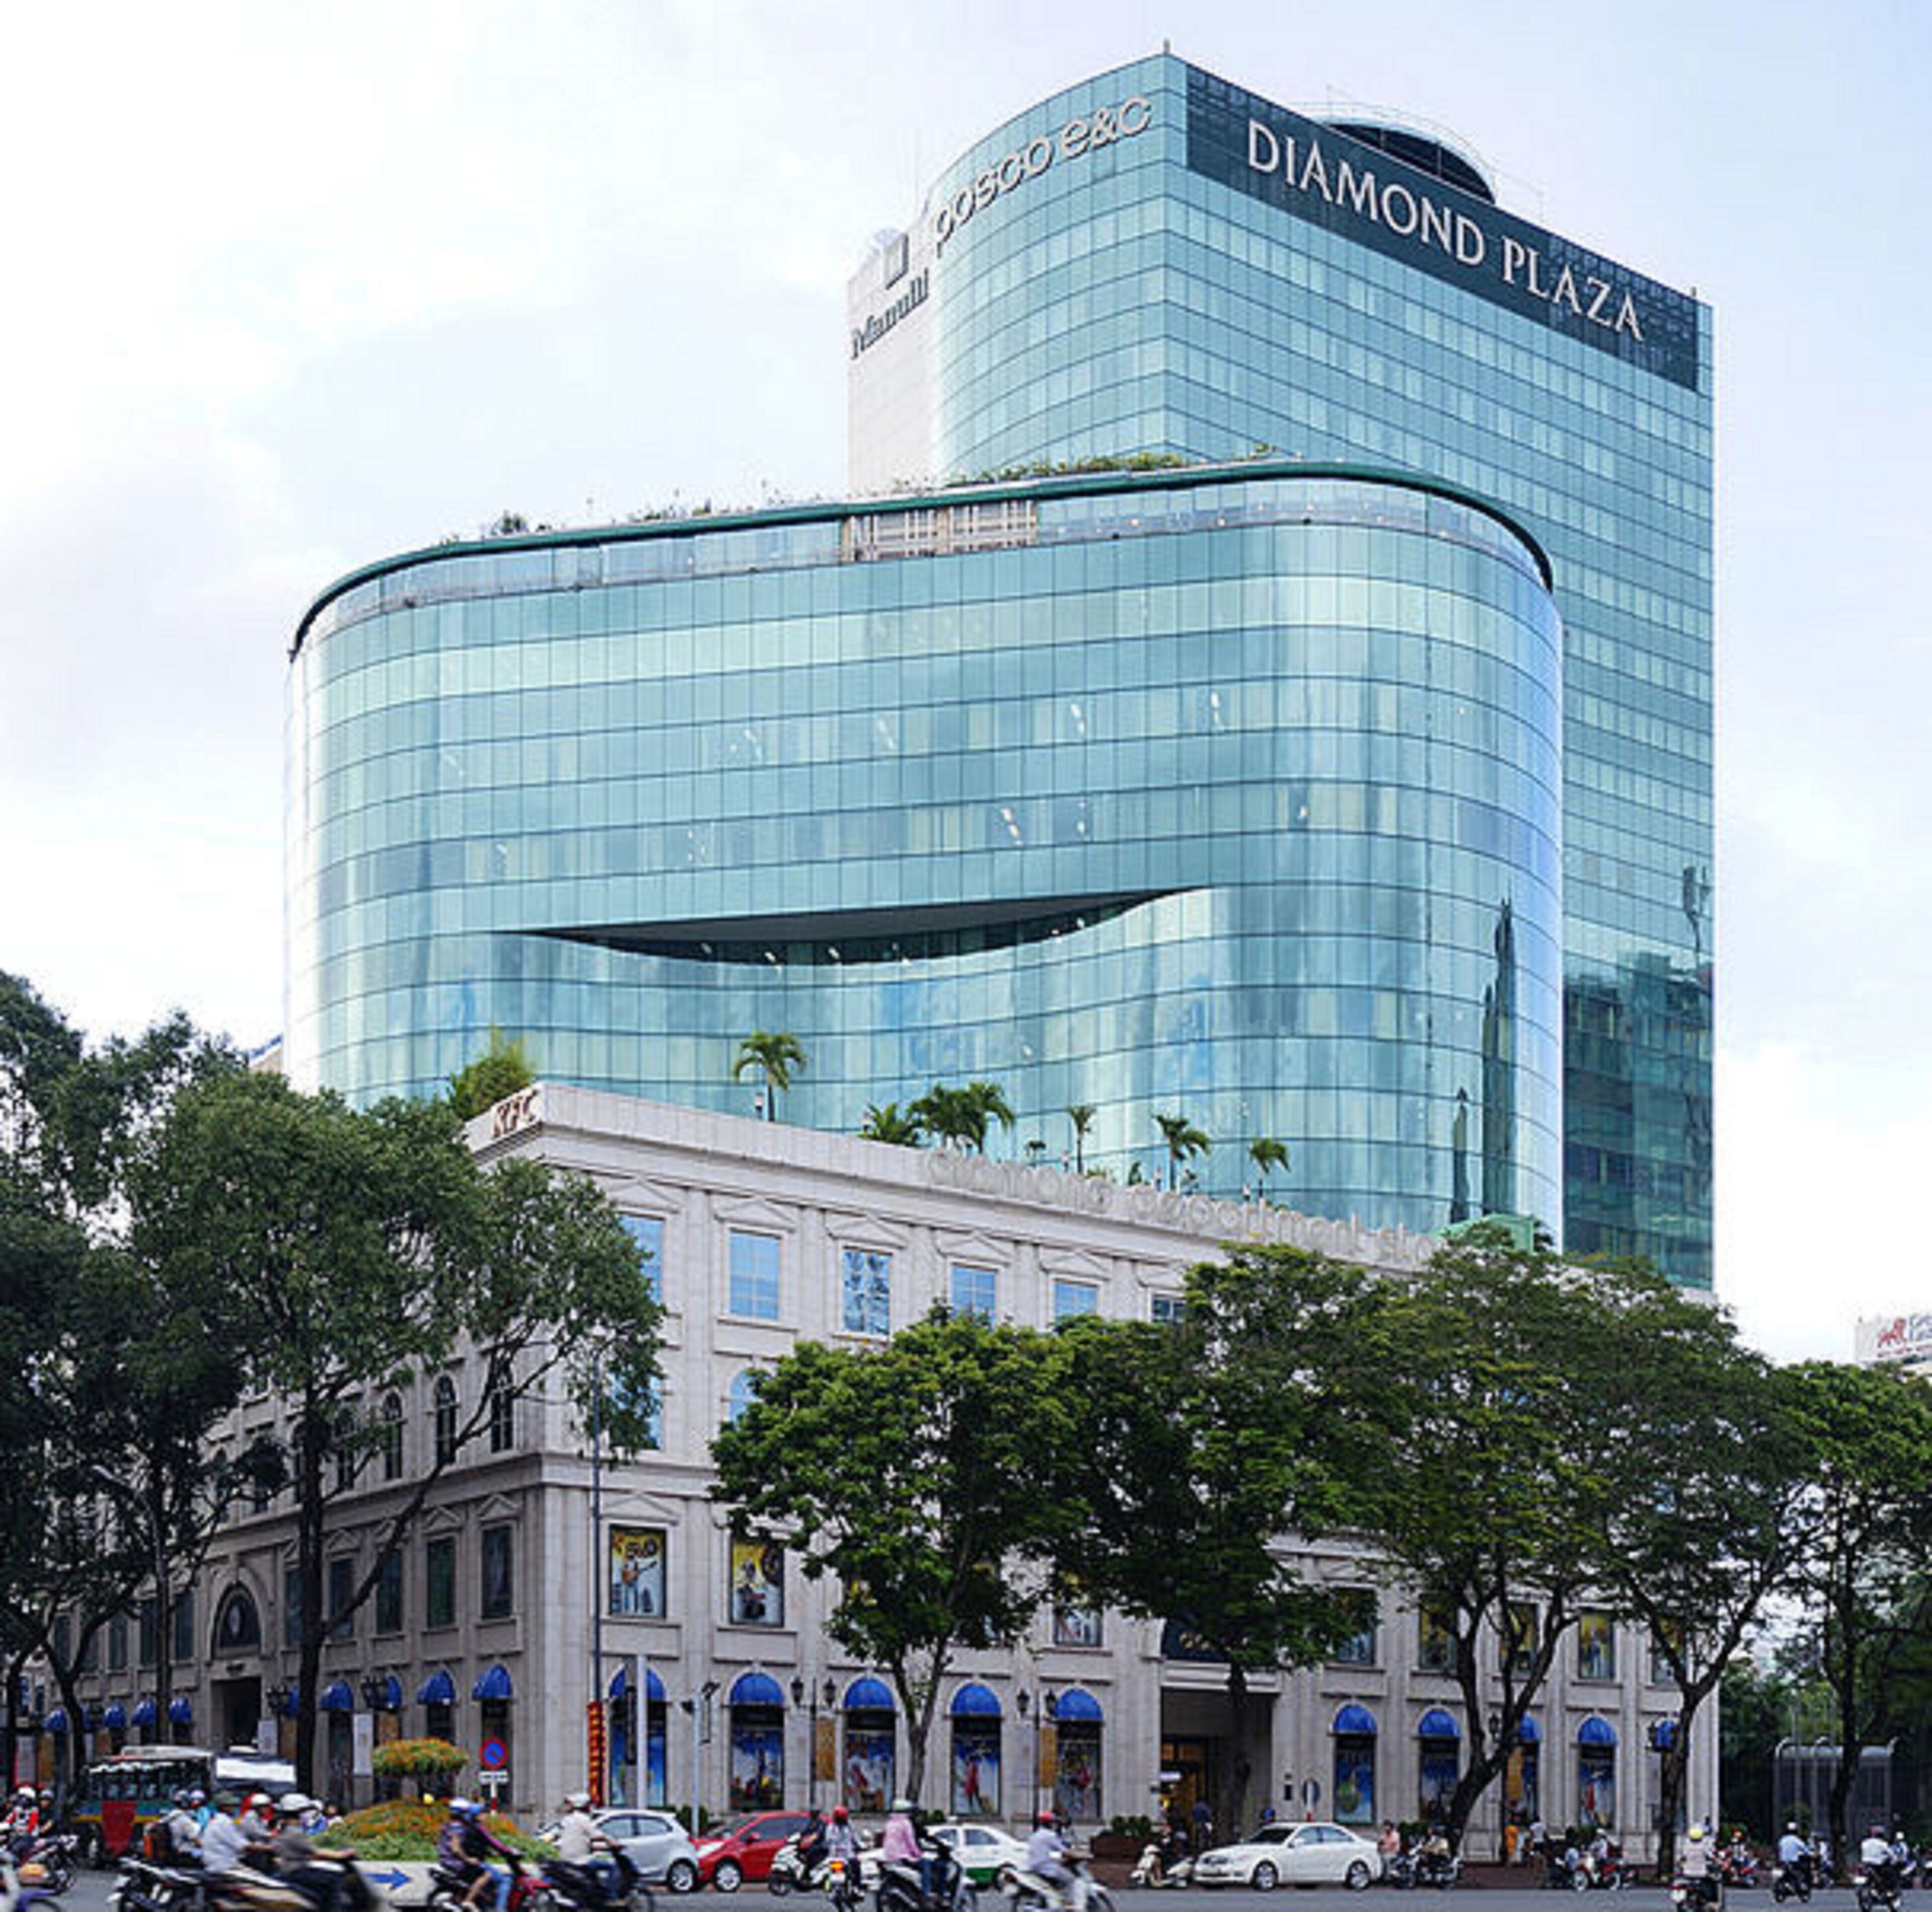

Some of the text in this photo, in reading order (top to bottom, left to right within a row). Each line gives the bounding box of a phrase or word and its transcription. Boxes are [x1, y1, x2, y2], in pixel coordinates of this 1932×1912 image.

[932, 134, 1055, 259] posco
[1248, 119, 1644, 341] DIAMOND PLAZA
